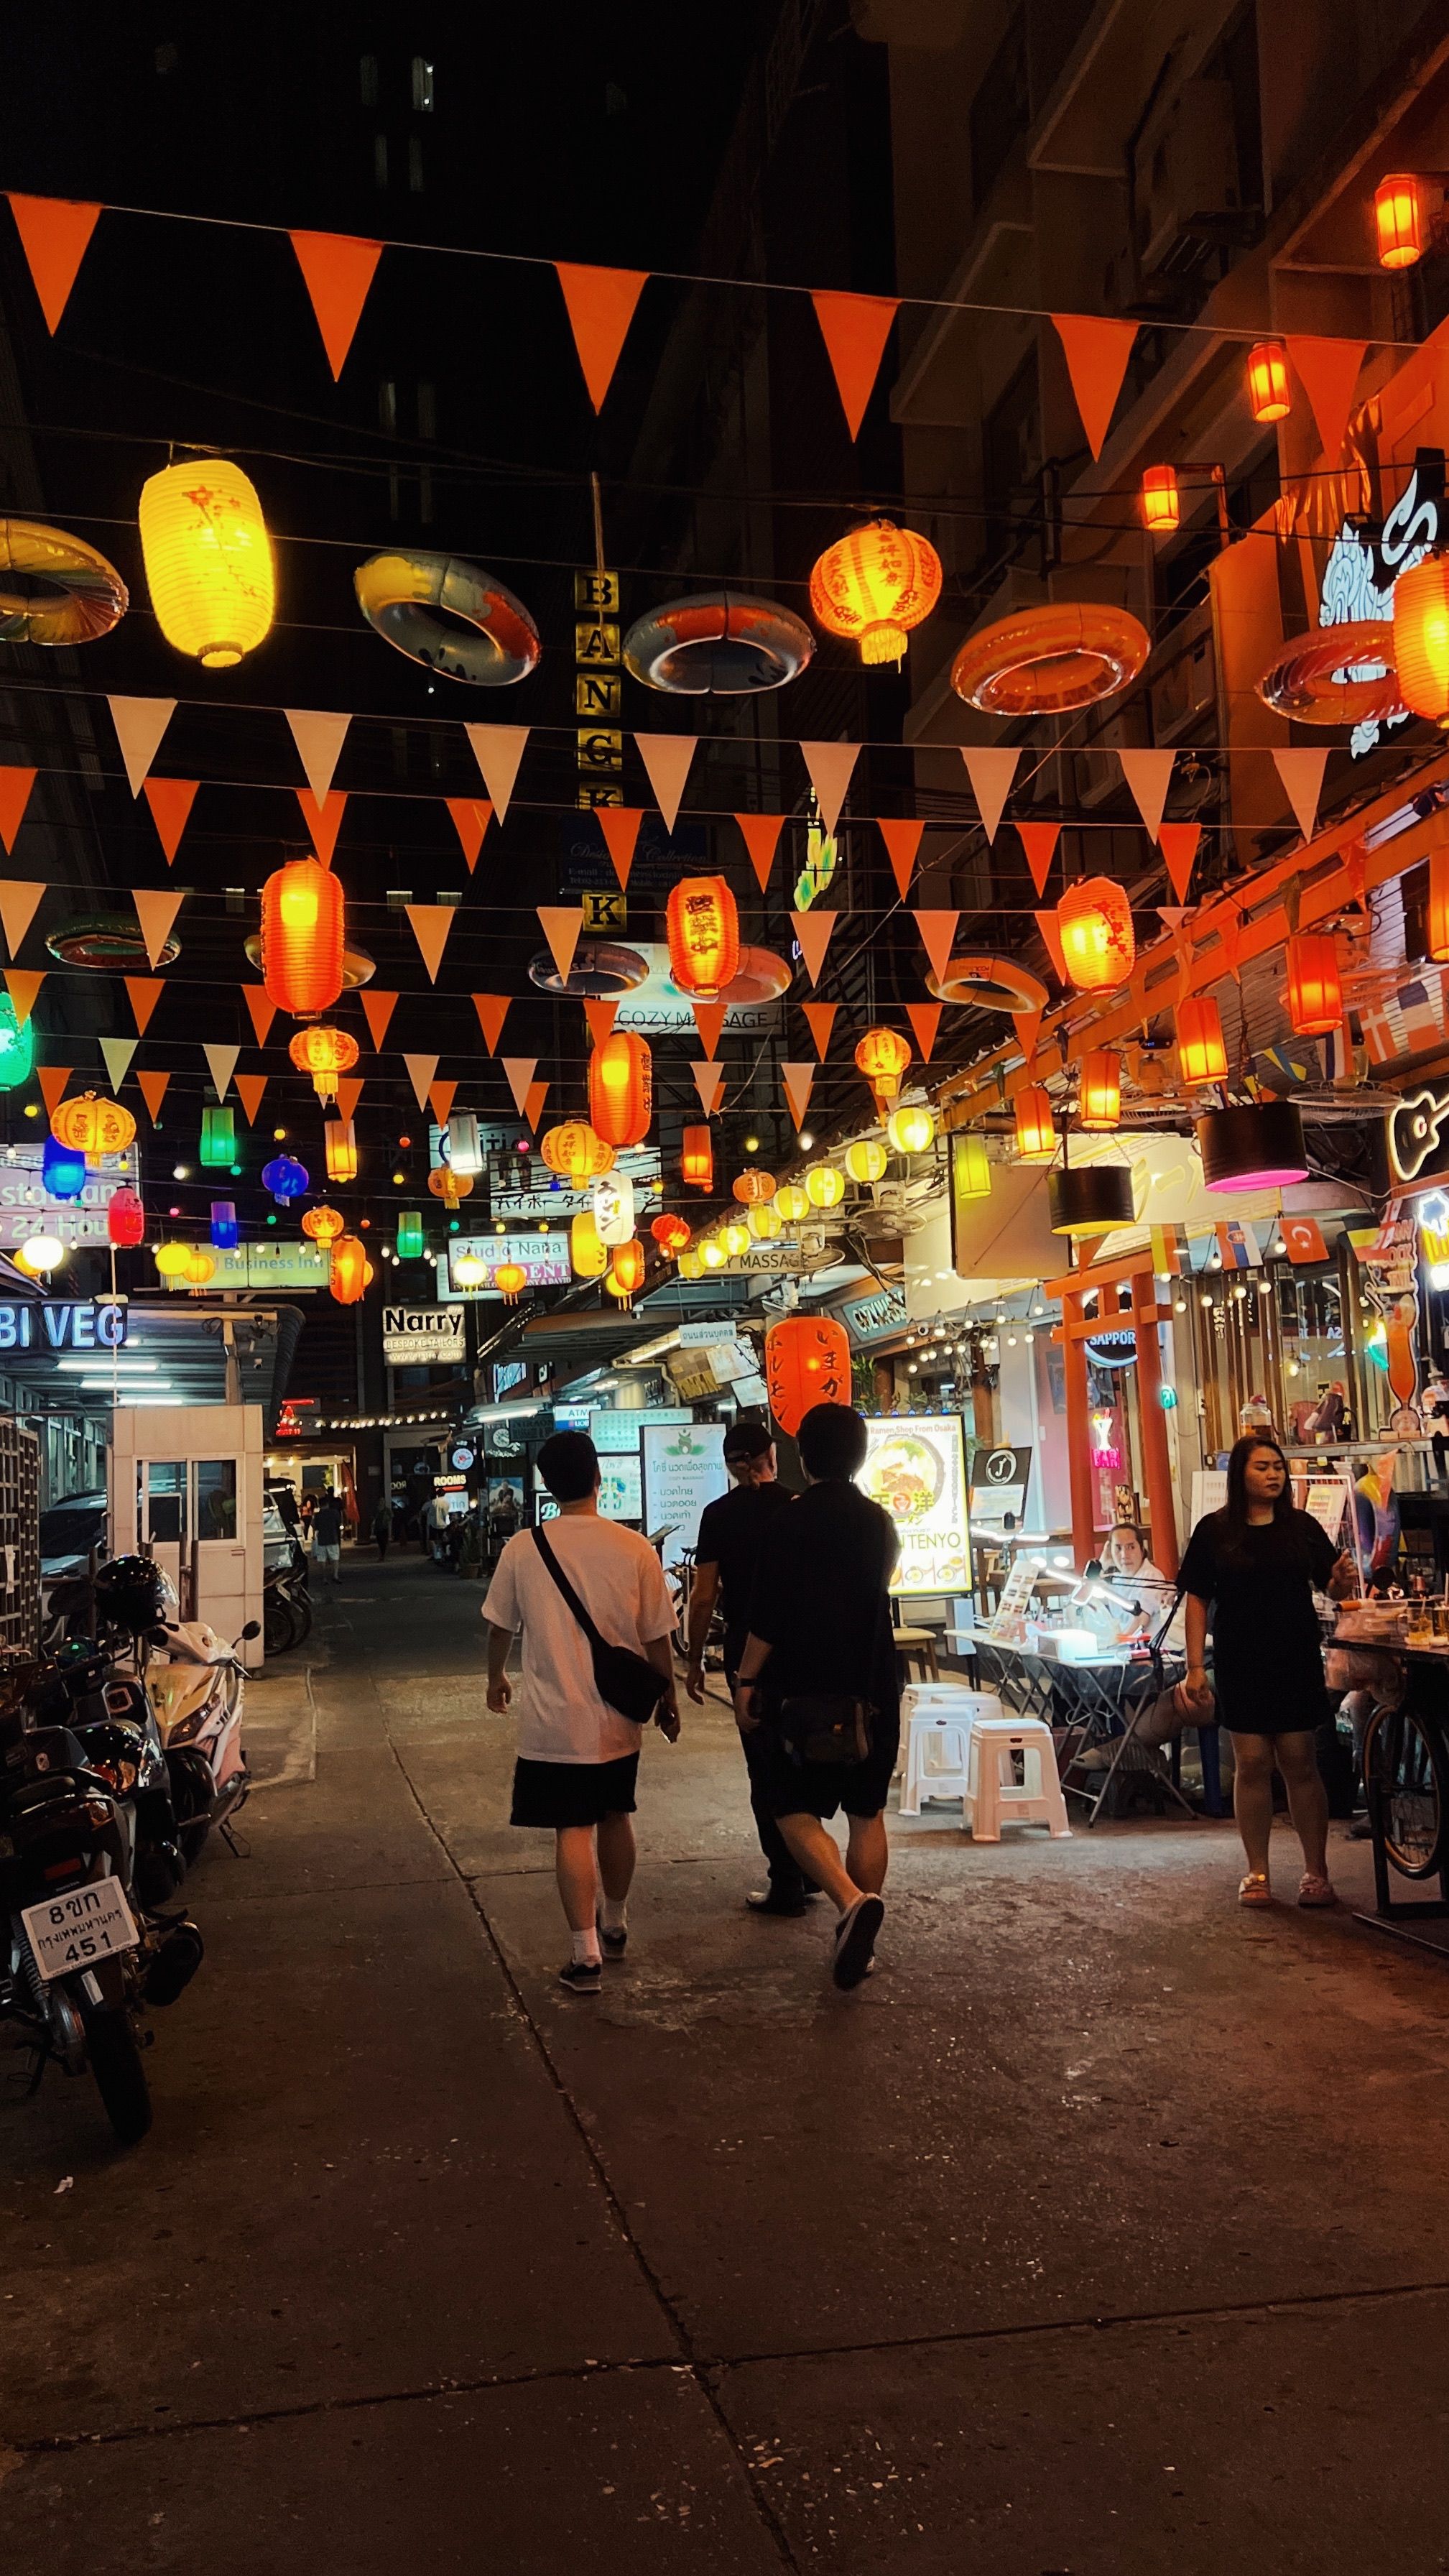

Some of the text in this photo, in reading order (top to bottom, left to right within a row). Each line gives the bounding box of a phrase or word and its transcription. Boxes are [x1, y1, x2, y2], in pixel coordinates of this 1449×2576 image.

[583, 576, 622, 925] BANGKK
[619, 1010, 768, 1028] COZY MAGE
[11, 1214, 108, 1239] 24 Hou
[224, 1257, 293, 1270] Business
[548, 1276, 572, 1285] DAVID
[0, 1305, 124, 1347] BI VEG
[385, 1308, 462, 1336] Narry
[386, 1337, 464, 1349] BESPOKE TAILORS
[1089, 1330, 1137, 1346] SAPPOR
[819, 1329, 845, 1401] いまが
[766, 1331, 789, 1422] ホルモン
[870, 1423, 956, 1435] Ramen Shop From Osaka
[1093, 1448, 1120, 1469] BAR
[433, 1474, 467, 1487] ROOMS
[895, 1514, 923, 1525] ーメン
[907, 1532, 961, 1549] TENYO
[37, 1908, 123, 1950] กรุงเทพมหานคร
[65, 1930, 112, 1962] 451
